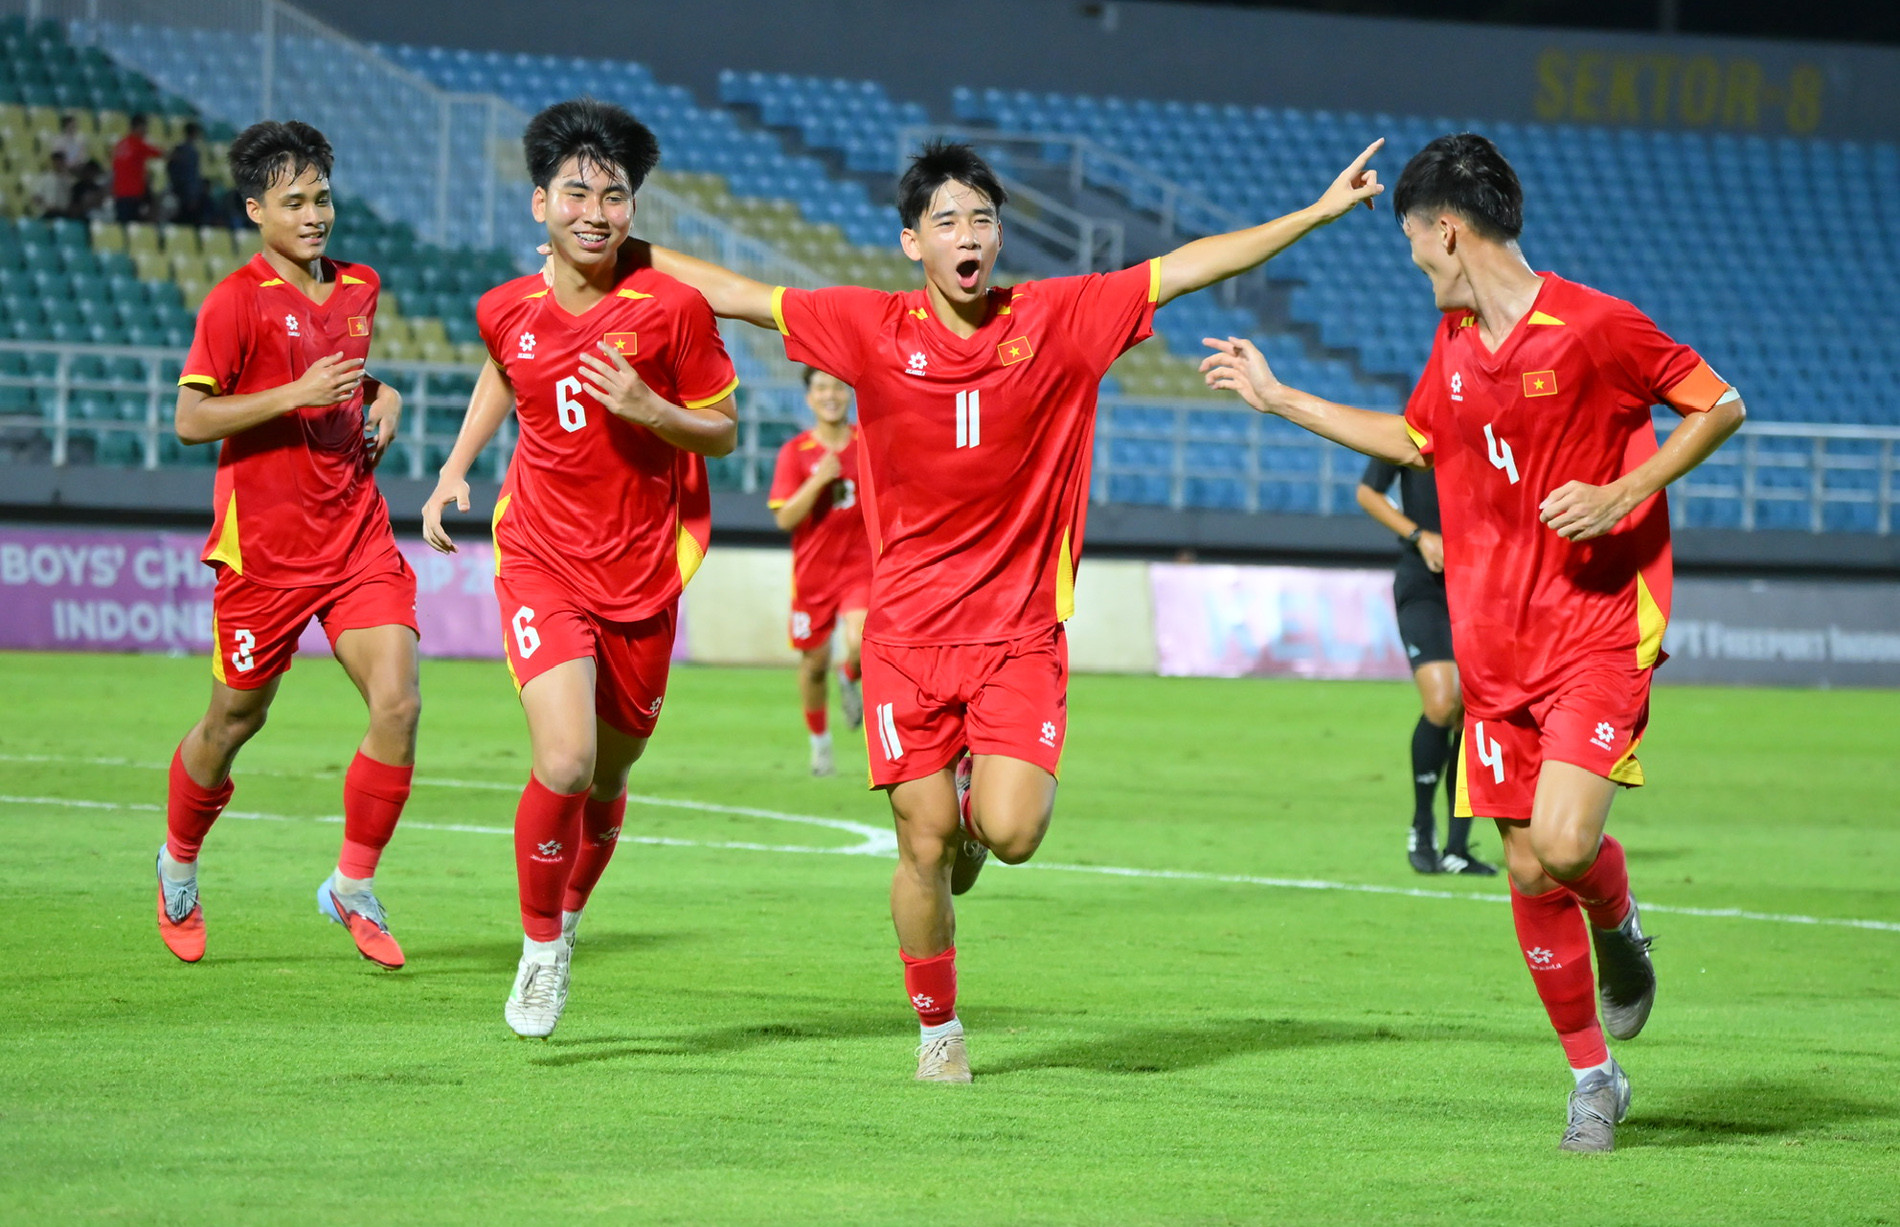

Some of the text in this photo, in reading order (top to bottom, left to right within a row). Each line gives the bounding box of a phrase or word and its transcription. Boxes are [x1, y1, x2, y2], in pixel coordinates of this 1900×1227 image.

[1533, 46, 1823, 133] SEKTOR-8
[556, 375, 587, 433] 6
[956, 389, 980, 449] 11
[1483, 422, 1520, 485] 4
[1, 543, 125, 588] BOYS'
[53, 600, 214, 641] INDONE
[512, 605, 541, 659] 6
[232, 629, 255, 672] 3
[876, 702, 904, 760] 11
[1475, 720, 1504, 784] 4
